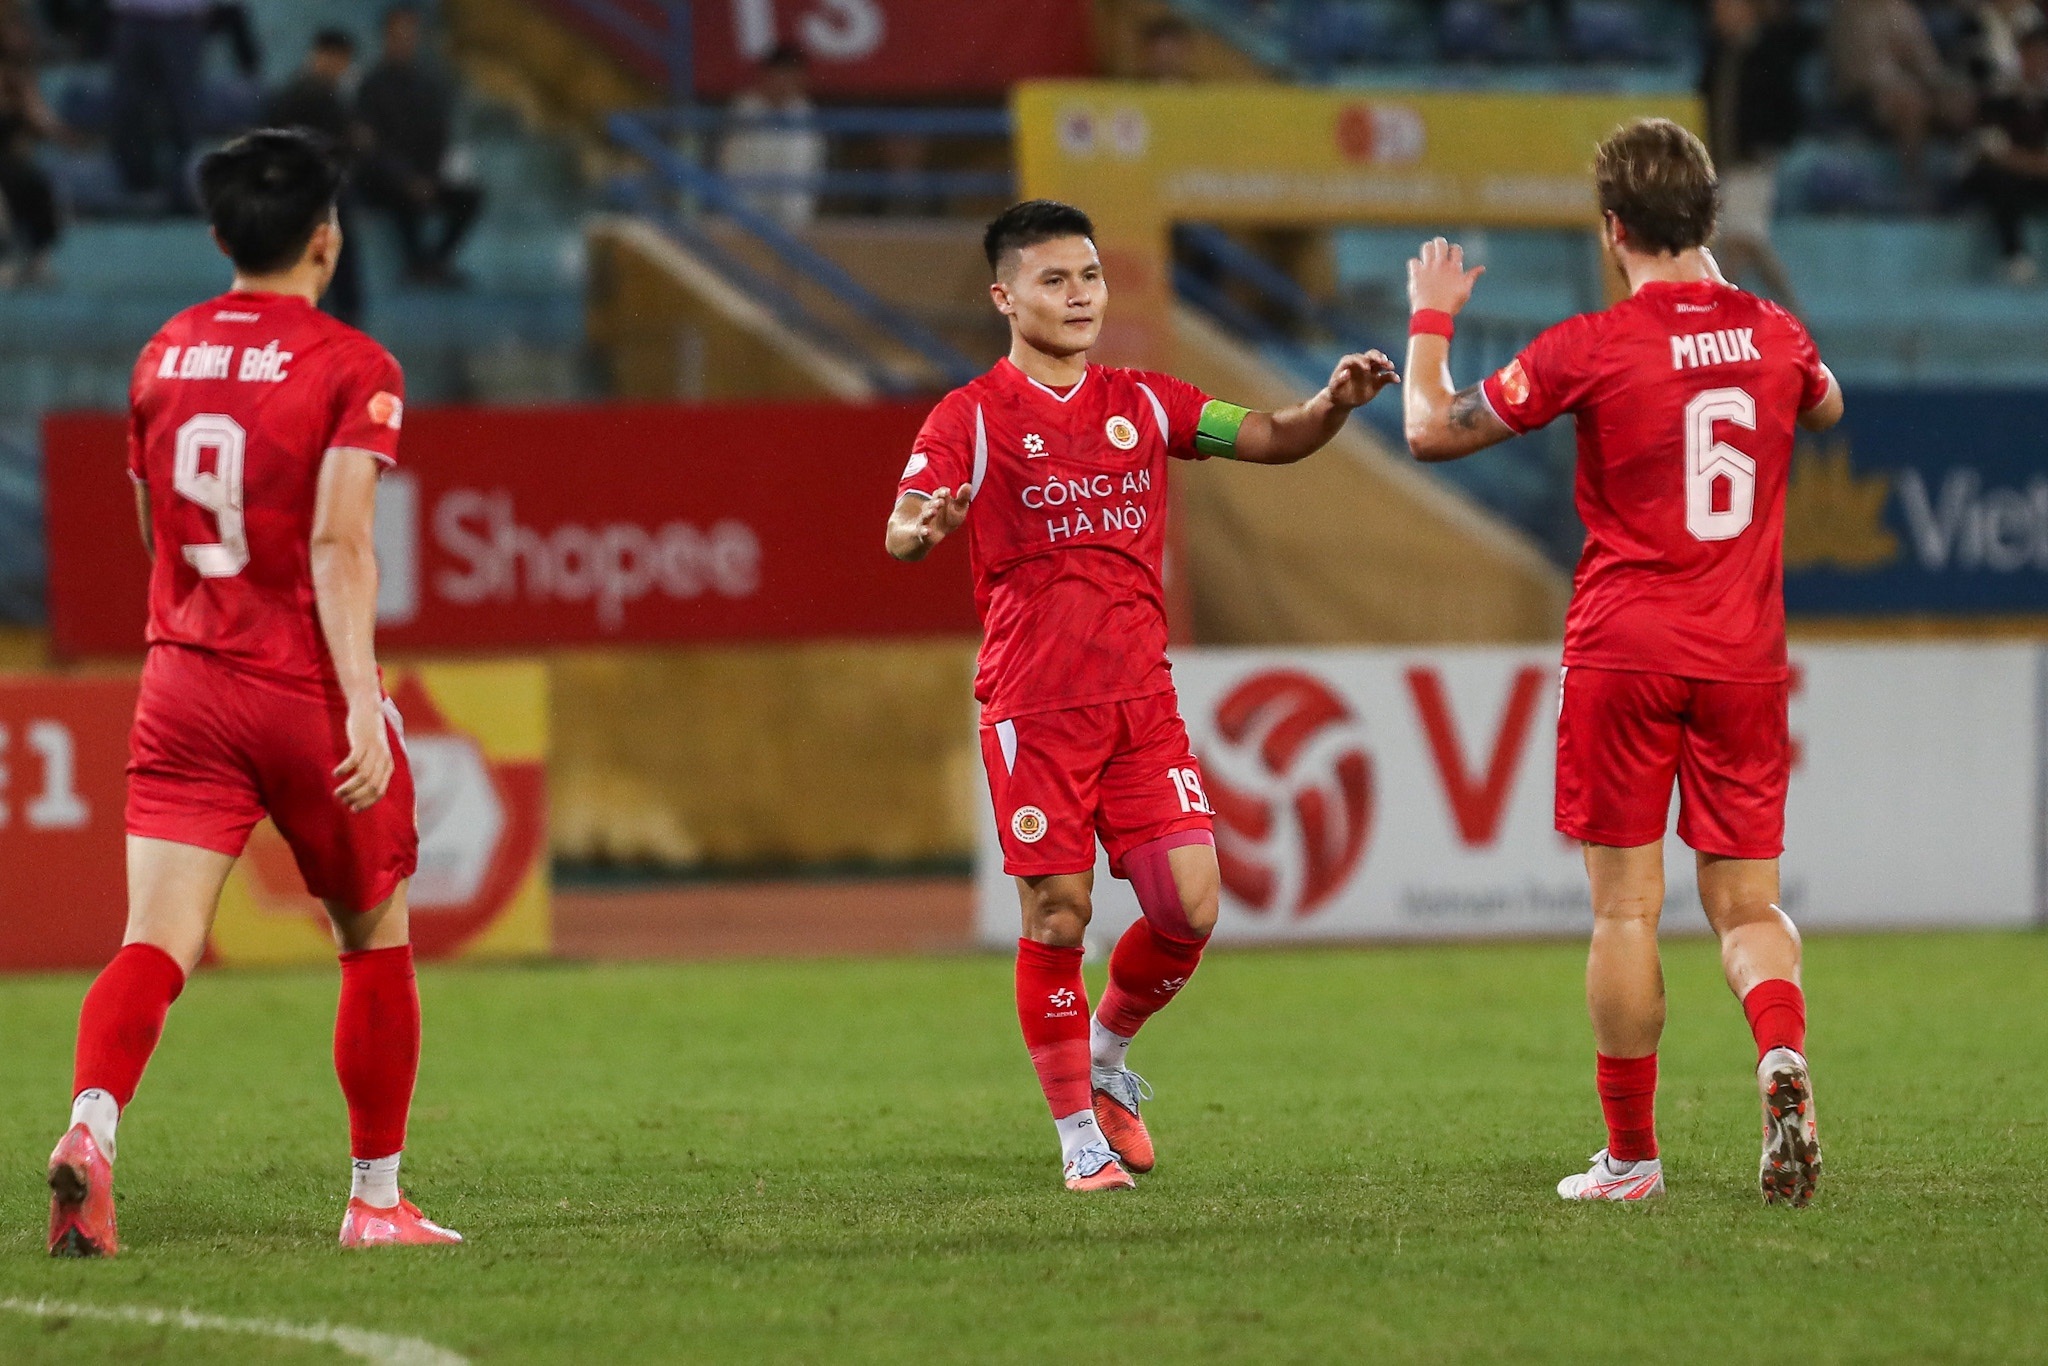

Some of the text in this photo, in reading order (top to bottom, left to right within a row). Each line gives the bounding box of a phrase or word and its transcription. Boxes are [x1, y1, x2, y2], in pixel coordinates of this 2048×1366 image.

[1670, 327, 1762, 370] MAUK
[1684, 387, 1756, 542] 6
[172, 413, 251, 578] 9
[1021, 468, 1151, 509] CÔNG AN
[1047, 500, 1147, 542] HÀ NỘI
[434, 488, 759, 630] Shopee
[1167, 768, 1216, 815] 19
